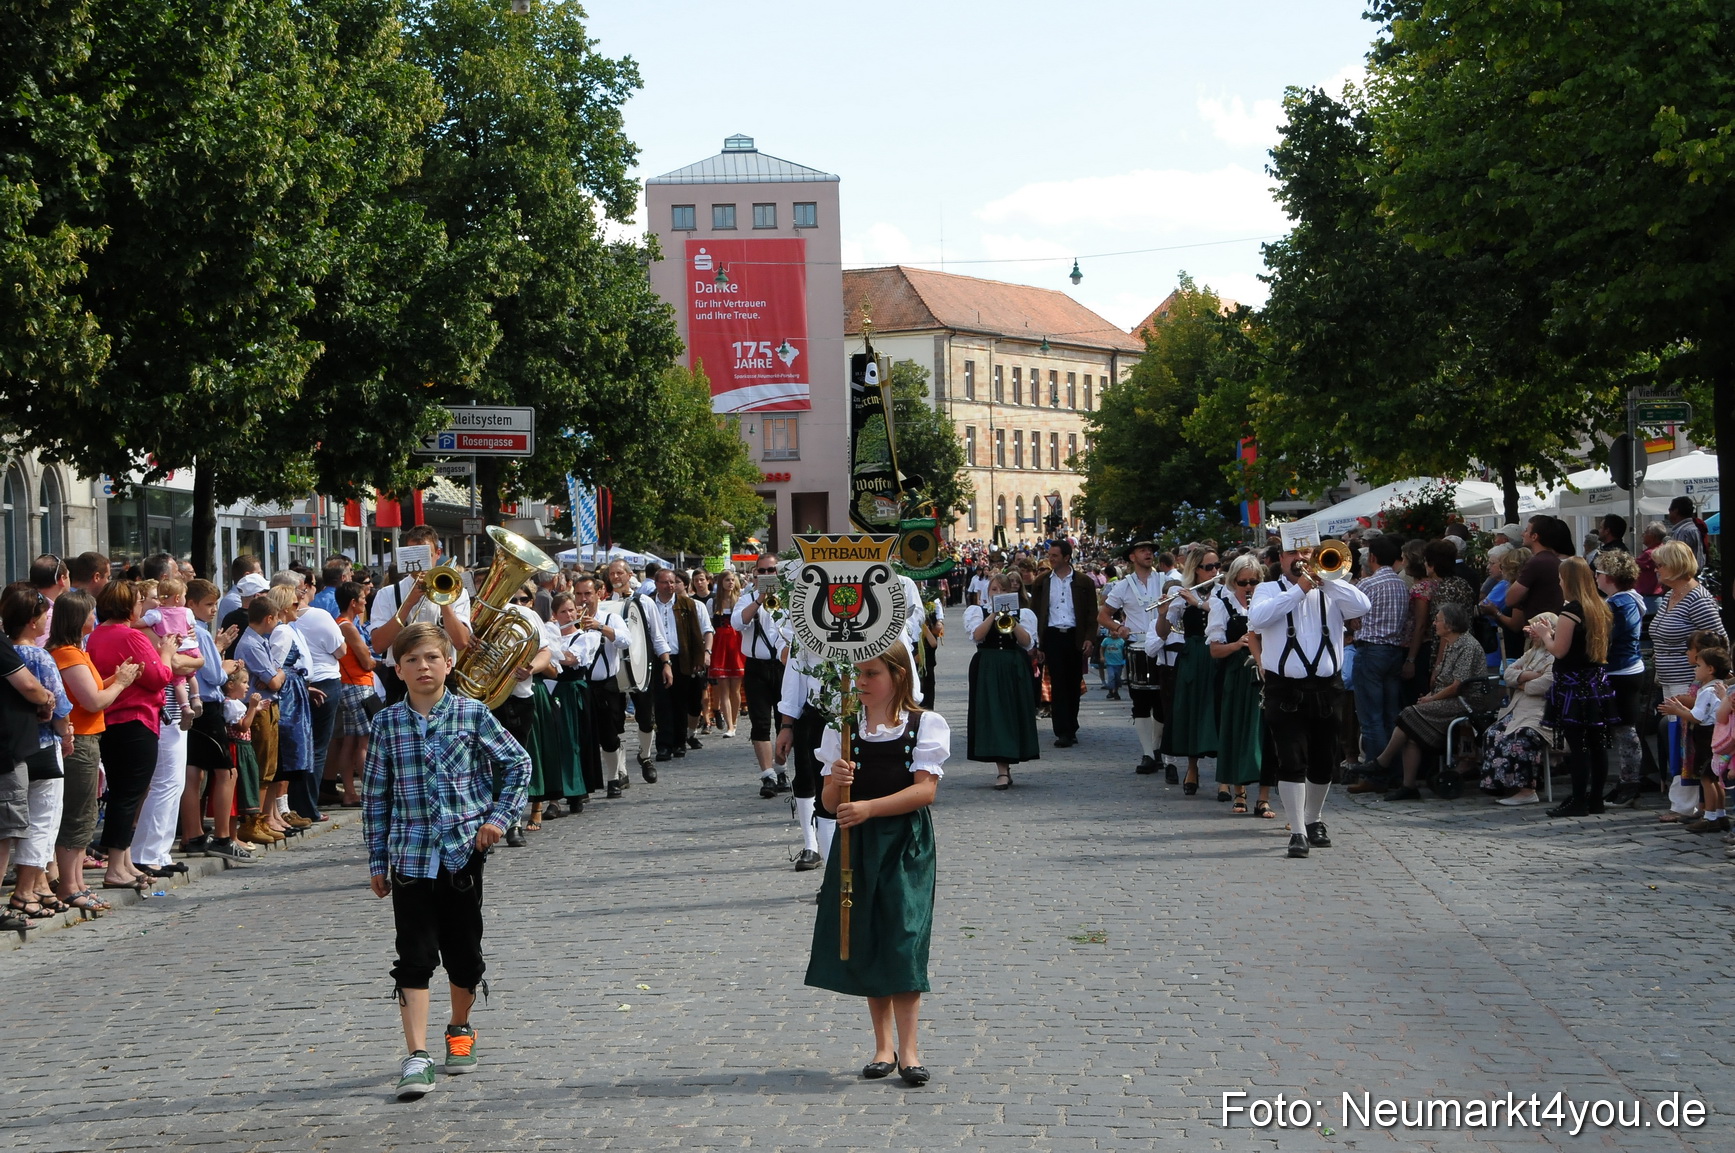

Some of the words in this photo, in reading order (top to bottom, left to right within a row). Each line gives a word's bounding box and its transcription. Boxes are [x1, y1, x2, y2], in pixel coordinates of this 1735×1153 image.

[695, 281, 738, 293] Danke
[695, 299, 708, 308] für
[710, 299, 722, 308] Ihr
[724, 299, 766, 308] Vertrauen
[695, 311, 713, 320] und
[715, 311, 732, 320] Ihre
[734, 311, 761, 320] Treue.
[732, 341, 773, 358] 175
[734, 358, 773, 369] JAHRE
[453, 413, 512, 428] kleitsystem
[462, 435, 513, 449] Rosengasse
[436, 465, 466, 475] sengasse
[855, 477, 894, 491] Woffen
[811, 547, 881, 560] PYRBAUM
[791, 583, 826, 655] MUSIKVEREIN
[826, 645, 850, 661] DER
[853, 582, 906, 662] MARKTGEMEINDE
